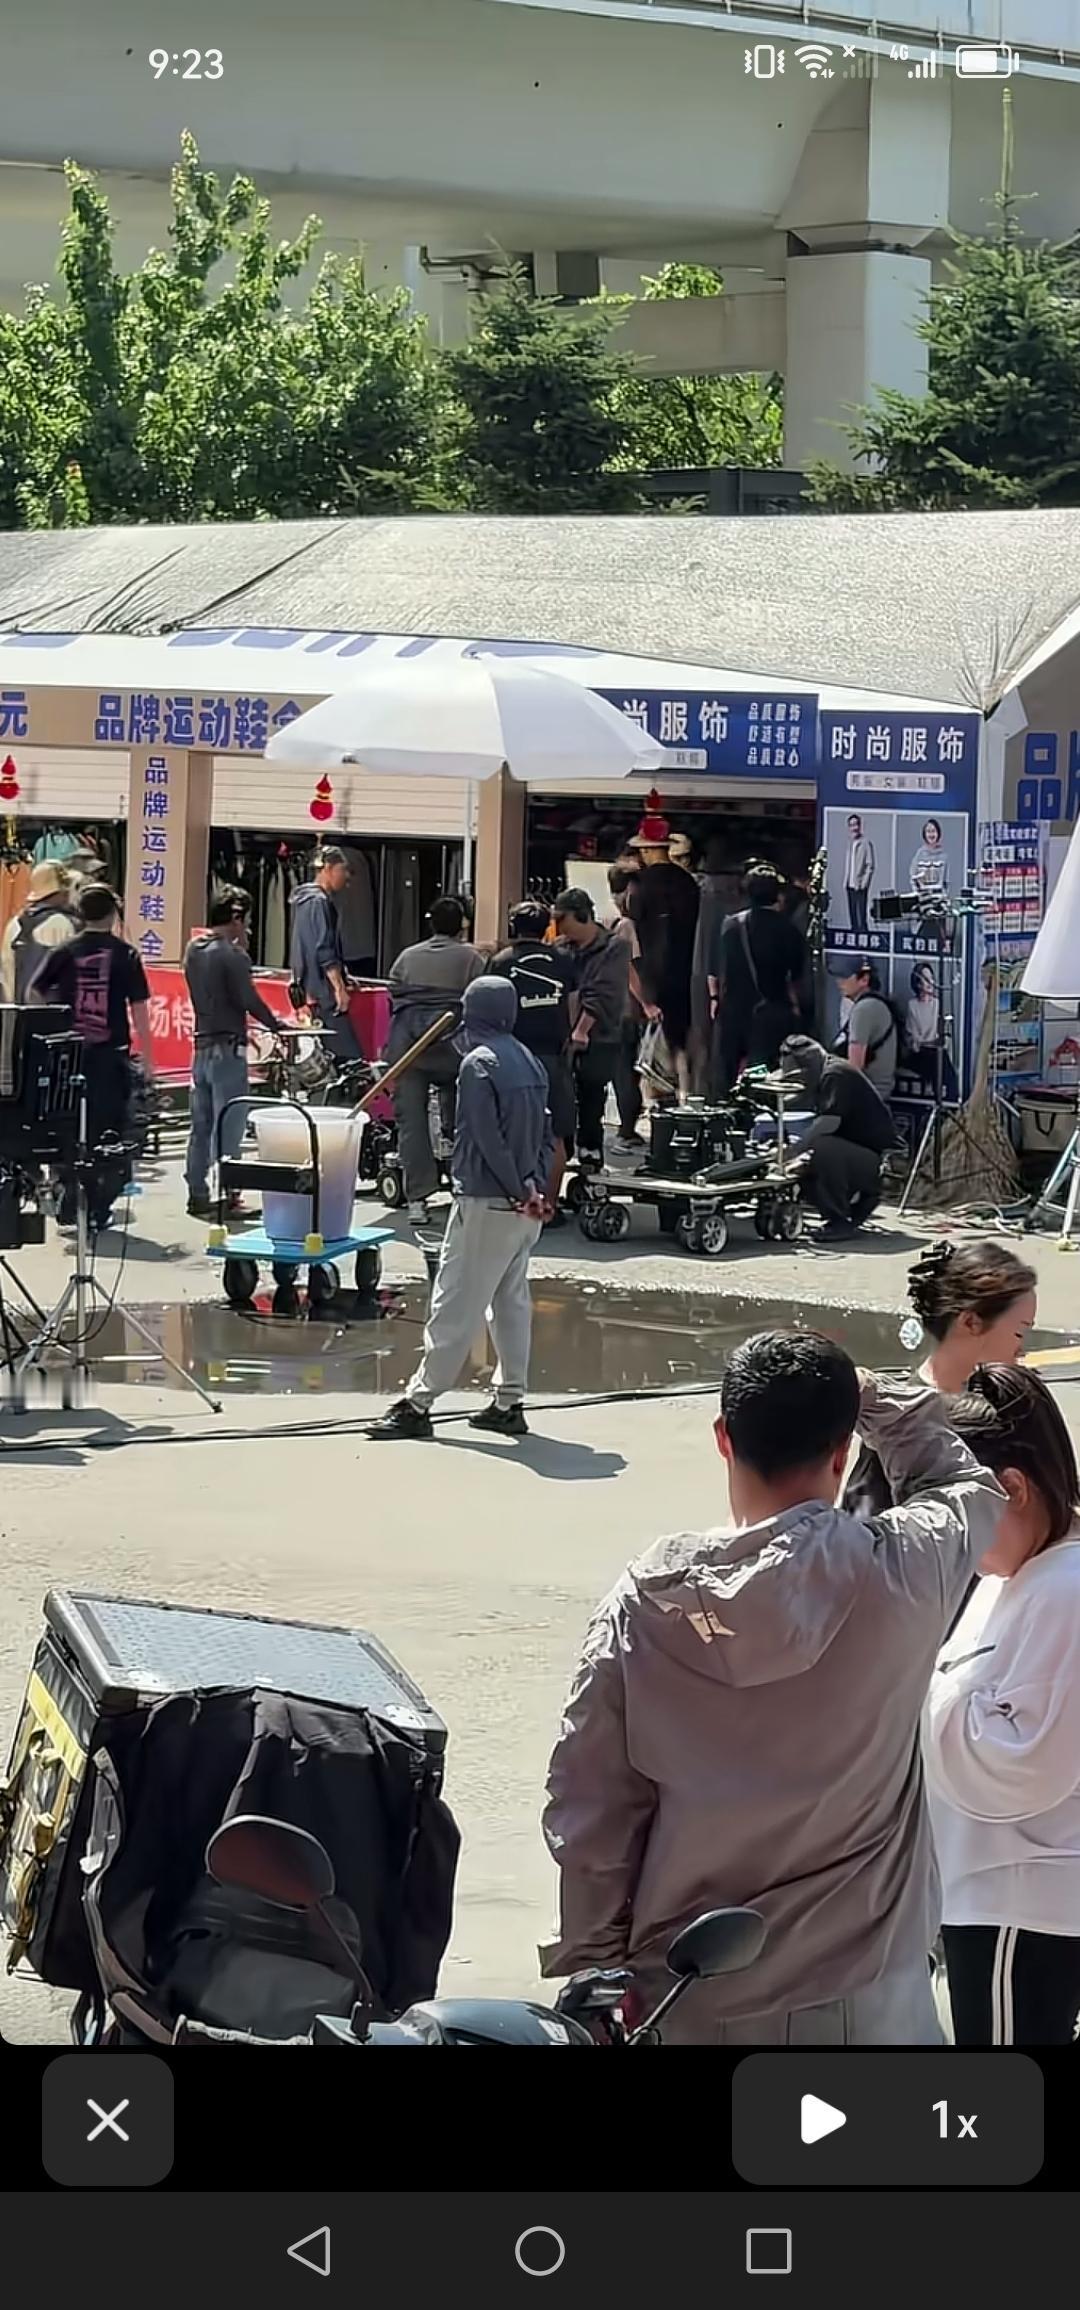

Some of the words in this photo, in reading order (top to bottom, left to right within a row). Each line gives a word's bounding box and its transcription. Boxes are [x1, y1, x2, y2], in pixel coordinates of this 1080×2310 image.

[0, 691, 28, 738] 元
[831, 724, 965, 764] 时尚服饰
[1017, 729, 1080, 821] 品
[138, 756, 169, 957] 品牌运动鞋全
